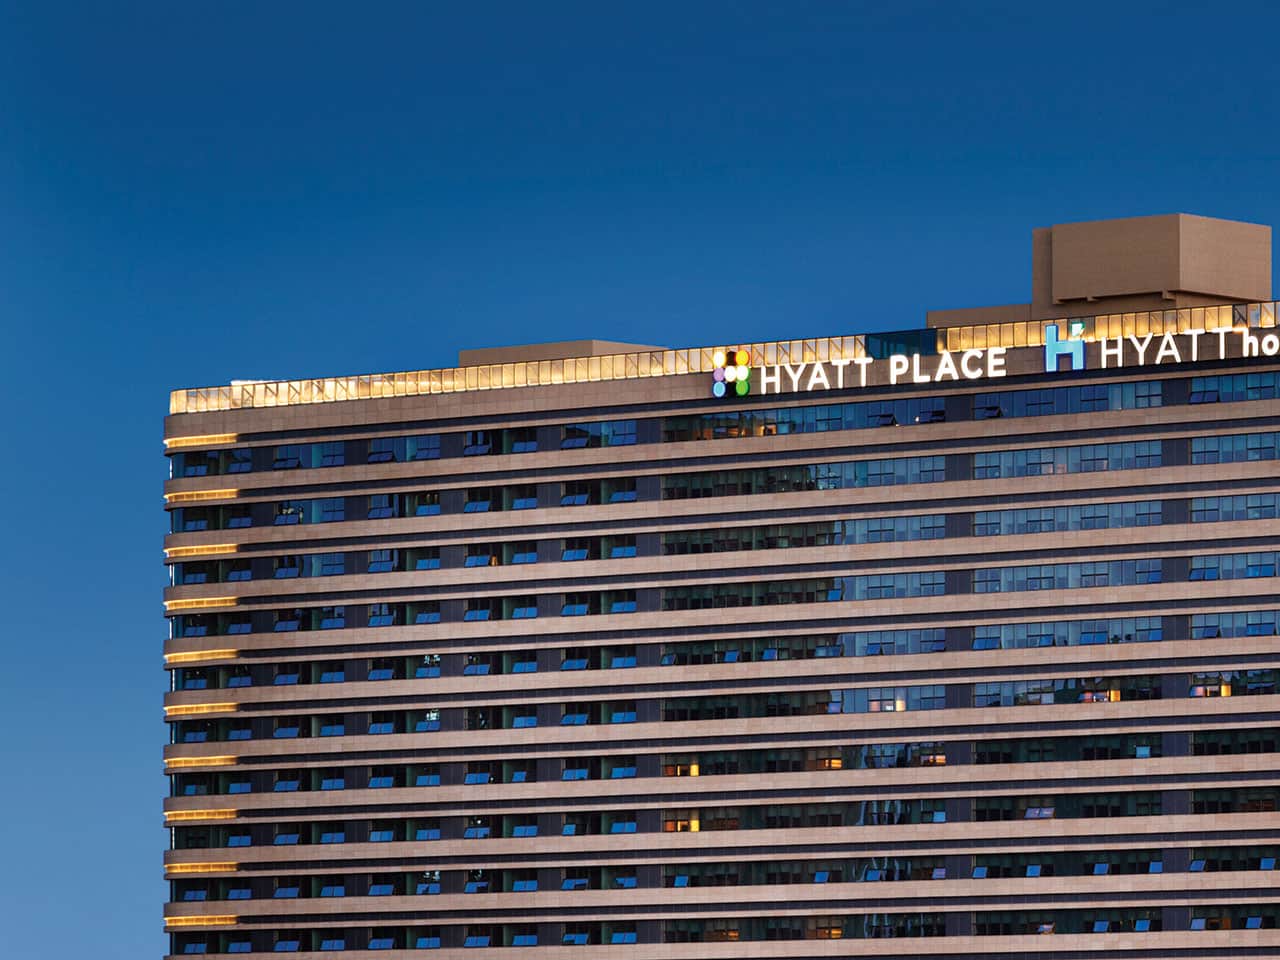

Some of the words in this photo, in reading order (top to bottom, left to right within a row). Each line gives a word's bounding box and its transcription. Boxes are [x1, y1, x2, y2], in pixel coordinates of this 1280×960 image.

[1100, 326, 1234, 369] HYATT
[760, 356, 874, 395] HYATT
[889, 347, 1008, 385] PLACE
